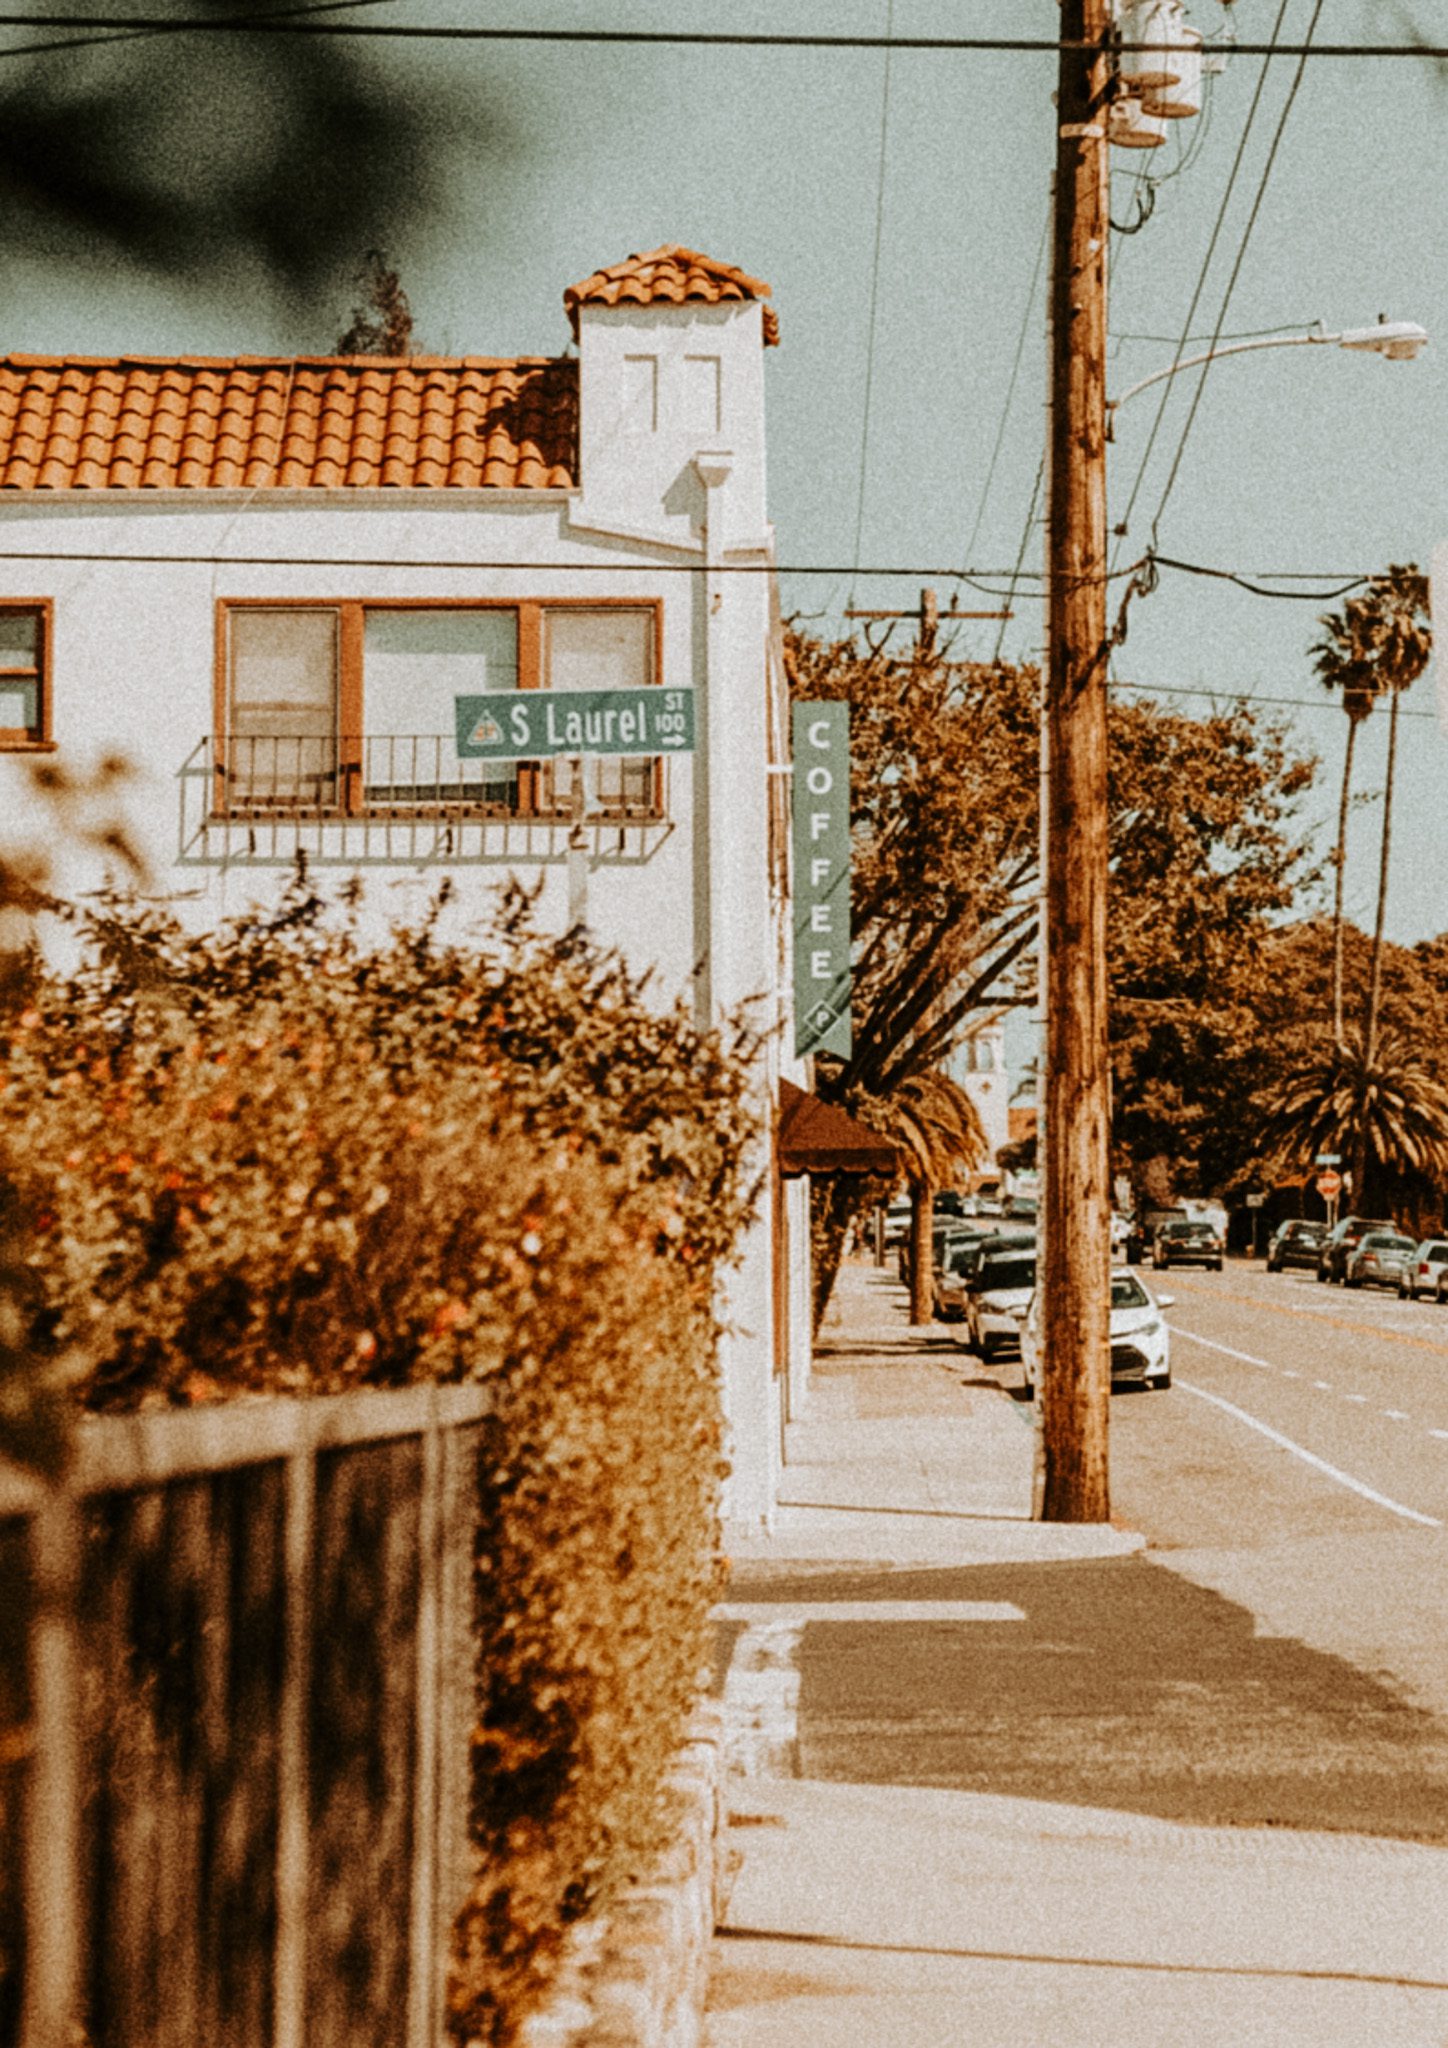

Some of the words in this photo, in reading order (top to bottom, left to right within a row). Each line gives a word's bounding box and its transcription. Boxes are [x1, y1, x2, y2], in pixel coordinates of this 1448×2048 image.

[665, 692, 685, 711] ST
[511, 703, 531, 746] S
[547, 701, 646, 746] Laurel
[655, 713, 685, 732] 100
[806, 721, 833, 978] COFFEE
